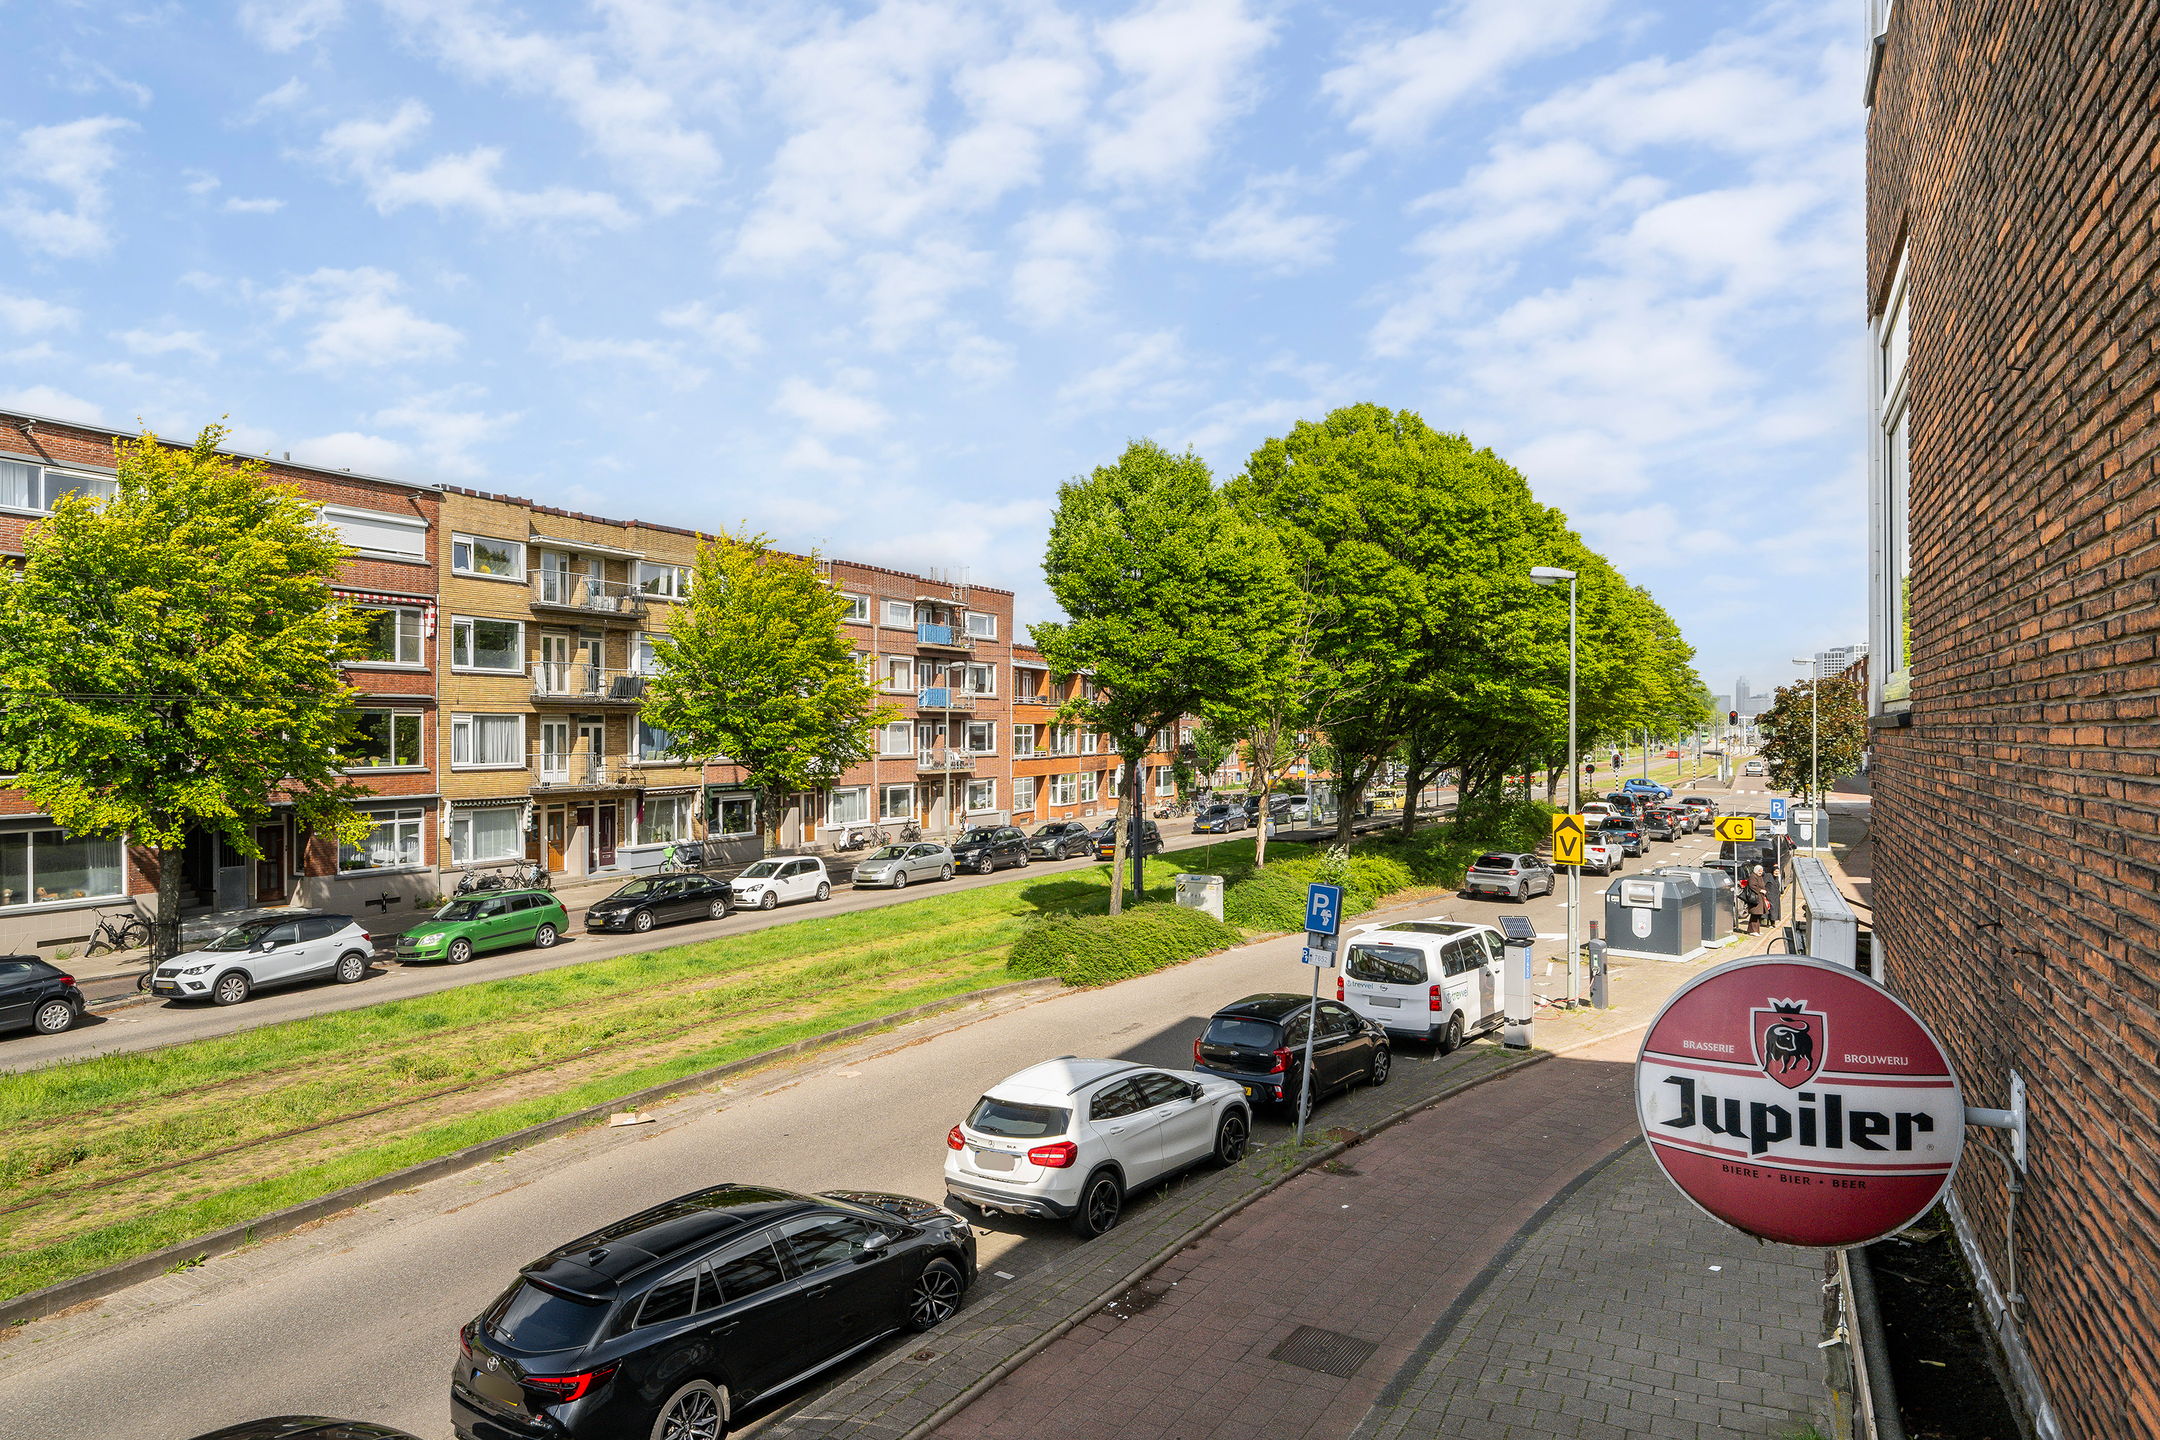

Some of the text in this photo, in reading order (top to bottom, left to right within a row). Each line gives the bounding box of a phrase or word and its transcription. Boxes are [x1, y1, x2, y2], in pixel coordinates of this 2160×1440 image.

[1772, 801, 1781, 813] P
[1733, 824, 1744, 836] G
[1559, 835, 1578, 857] V
[1312, 893, 1329, 915] P
[1682, 1039, 1735, 1054] BRASSERIE
[1844, 1053, 1909, 1067] BROUWERIJ
[1659, 1075, 1934, 1156] Jupiler
[1721, 1164, 1867, 1190] BIERE BIER BEER
